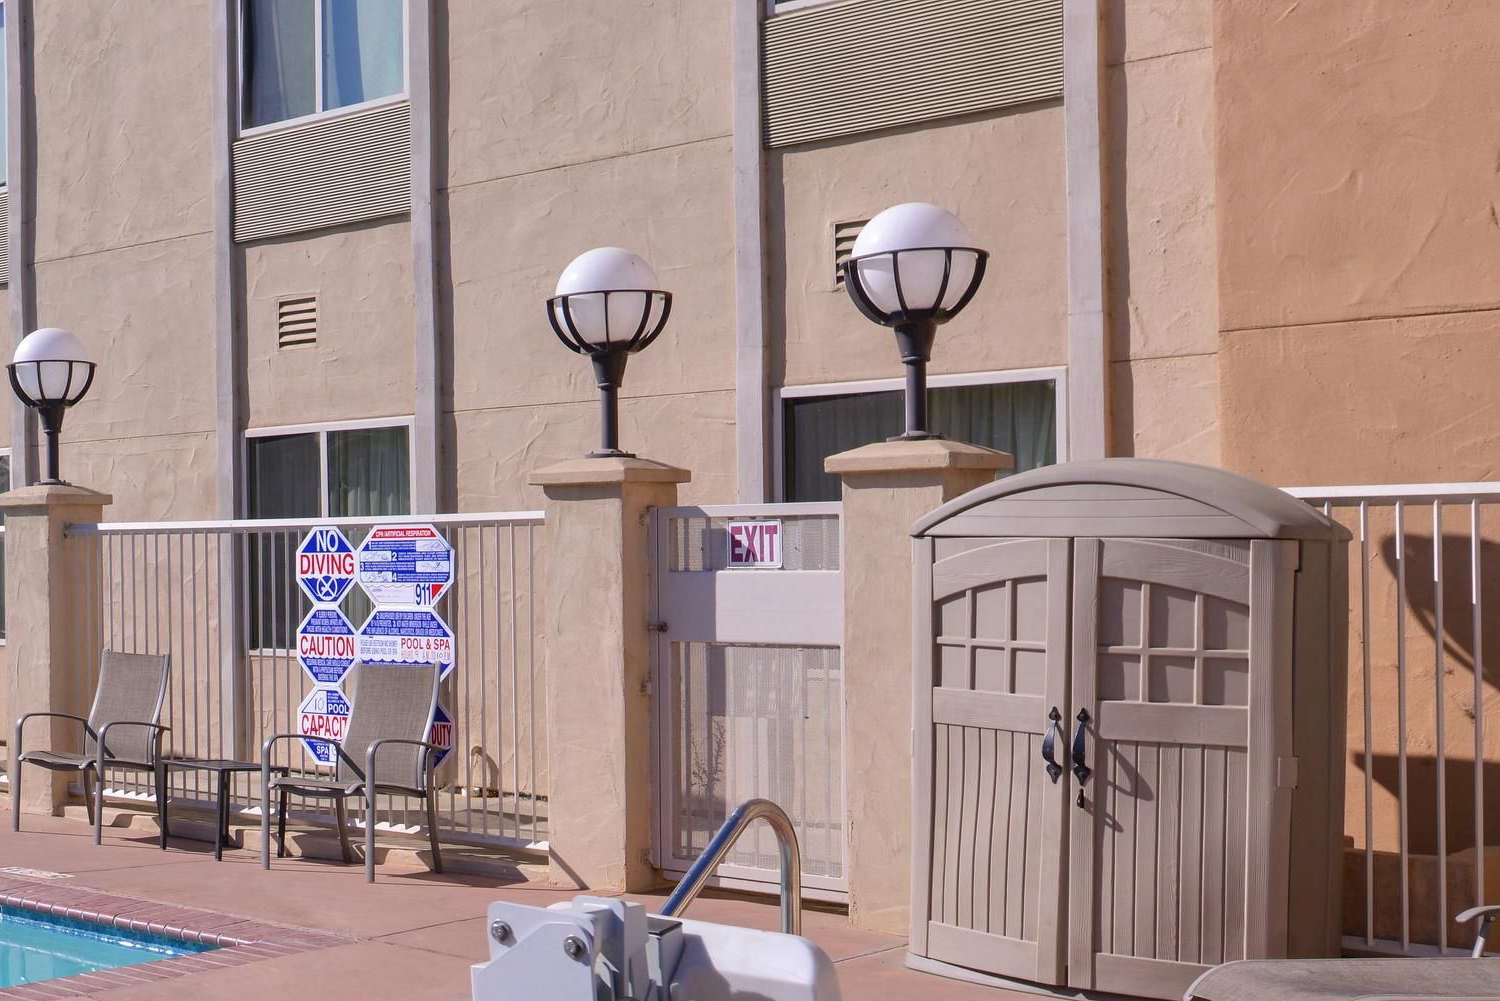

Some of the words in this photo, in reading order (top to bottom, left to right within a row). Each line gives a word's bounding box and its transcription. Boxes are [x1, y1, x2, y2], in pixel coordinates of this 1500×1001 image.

[316, 530, 339, 552] NO
[730, 524, 778, 563] EXIT
[300, 553, 355, 576] DIVING
[415, 583, 431, 606] 911
[300, 634, 355, 657] CAUTION
[400, 637, 424, 650] POOL
[425, 639, 432, 650] &
[433, 638, 451, 651] SPA
[315, 697, 325, 711] 10
[328, 703, 349, 714] POOL
[432, 723, 452, 747] DUTY
[316, 746, 329, 755] SPA
